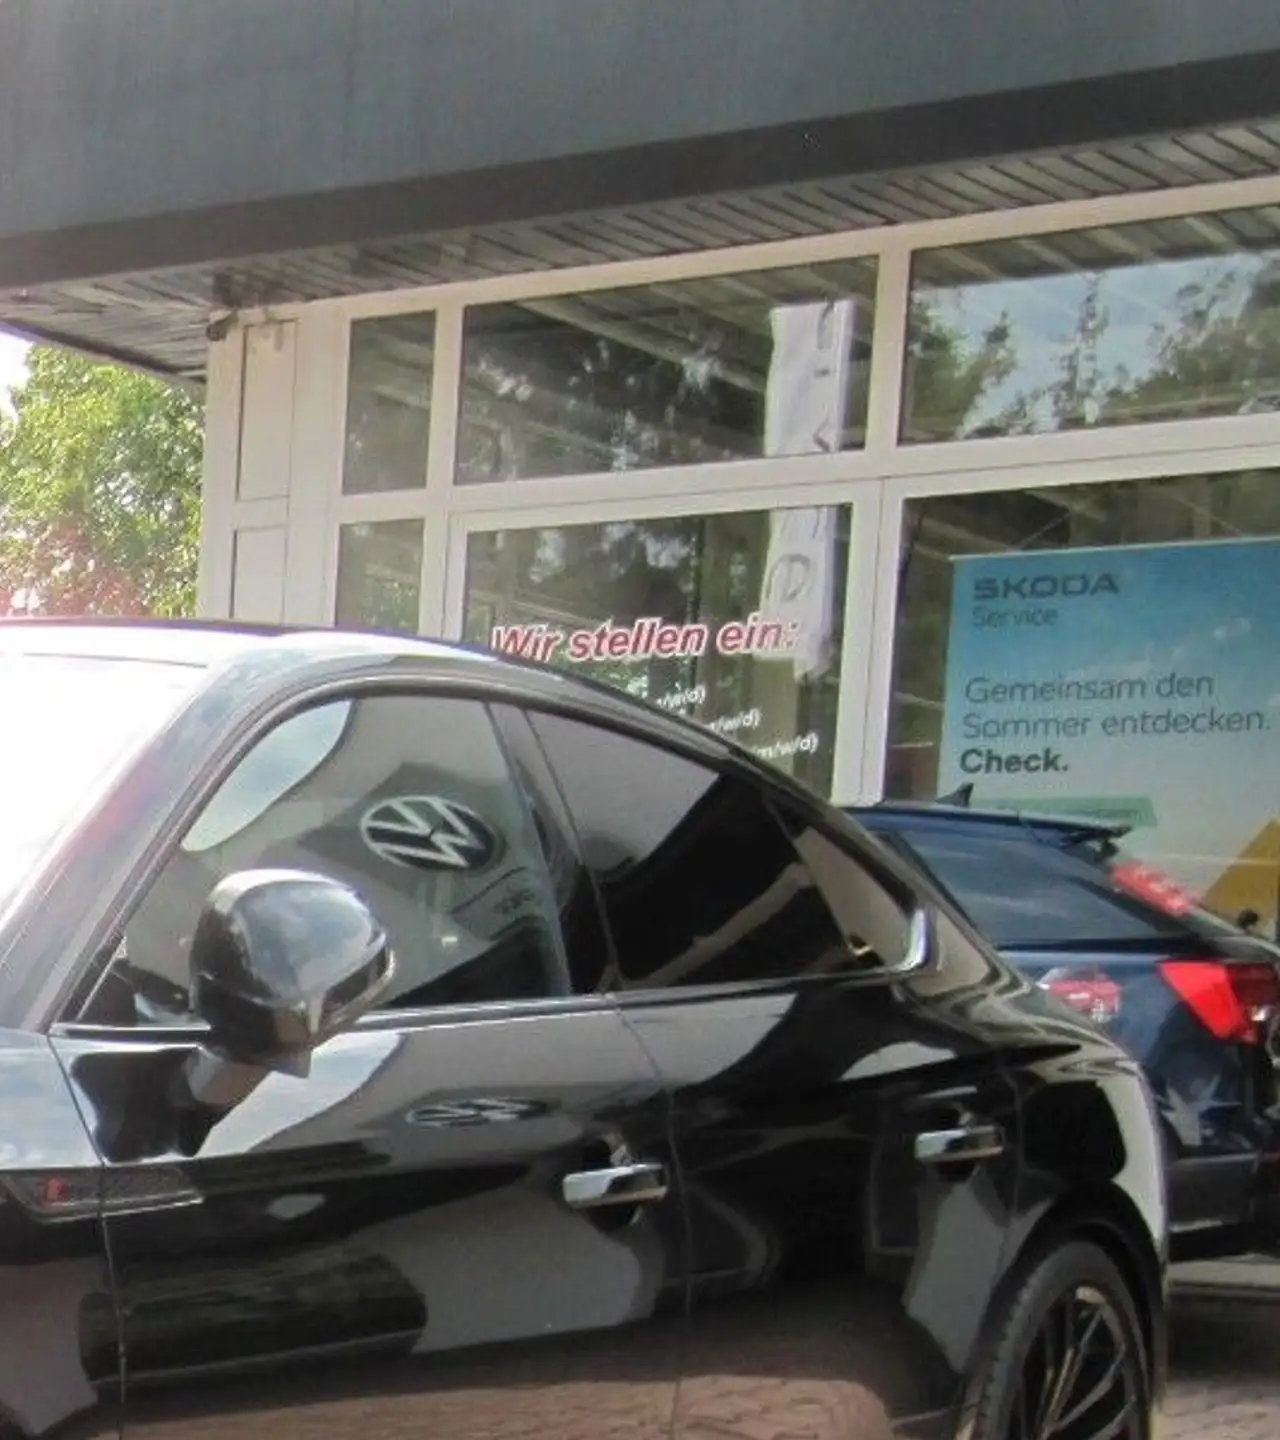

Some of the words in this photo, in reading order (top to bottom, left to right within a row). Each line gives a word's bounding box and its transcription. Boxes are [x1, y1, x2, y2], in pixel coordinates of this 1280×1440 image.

[971, 605, 1059, 630] Service
[491, 623, 560, 663] Wir
[568, 617, 708, 661] stellen
[965, 676, 1146, 704] Gemeinsam
[1155, 672, 1215, 698] den
[961, 711, 1093, 740] Sommer
[1100, 706, 1272, 737] entdecken.
[959, 747, 1070, 775] Check.
